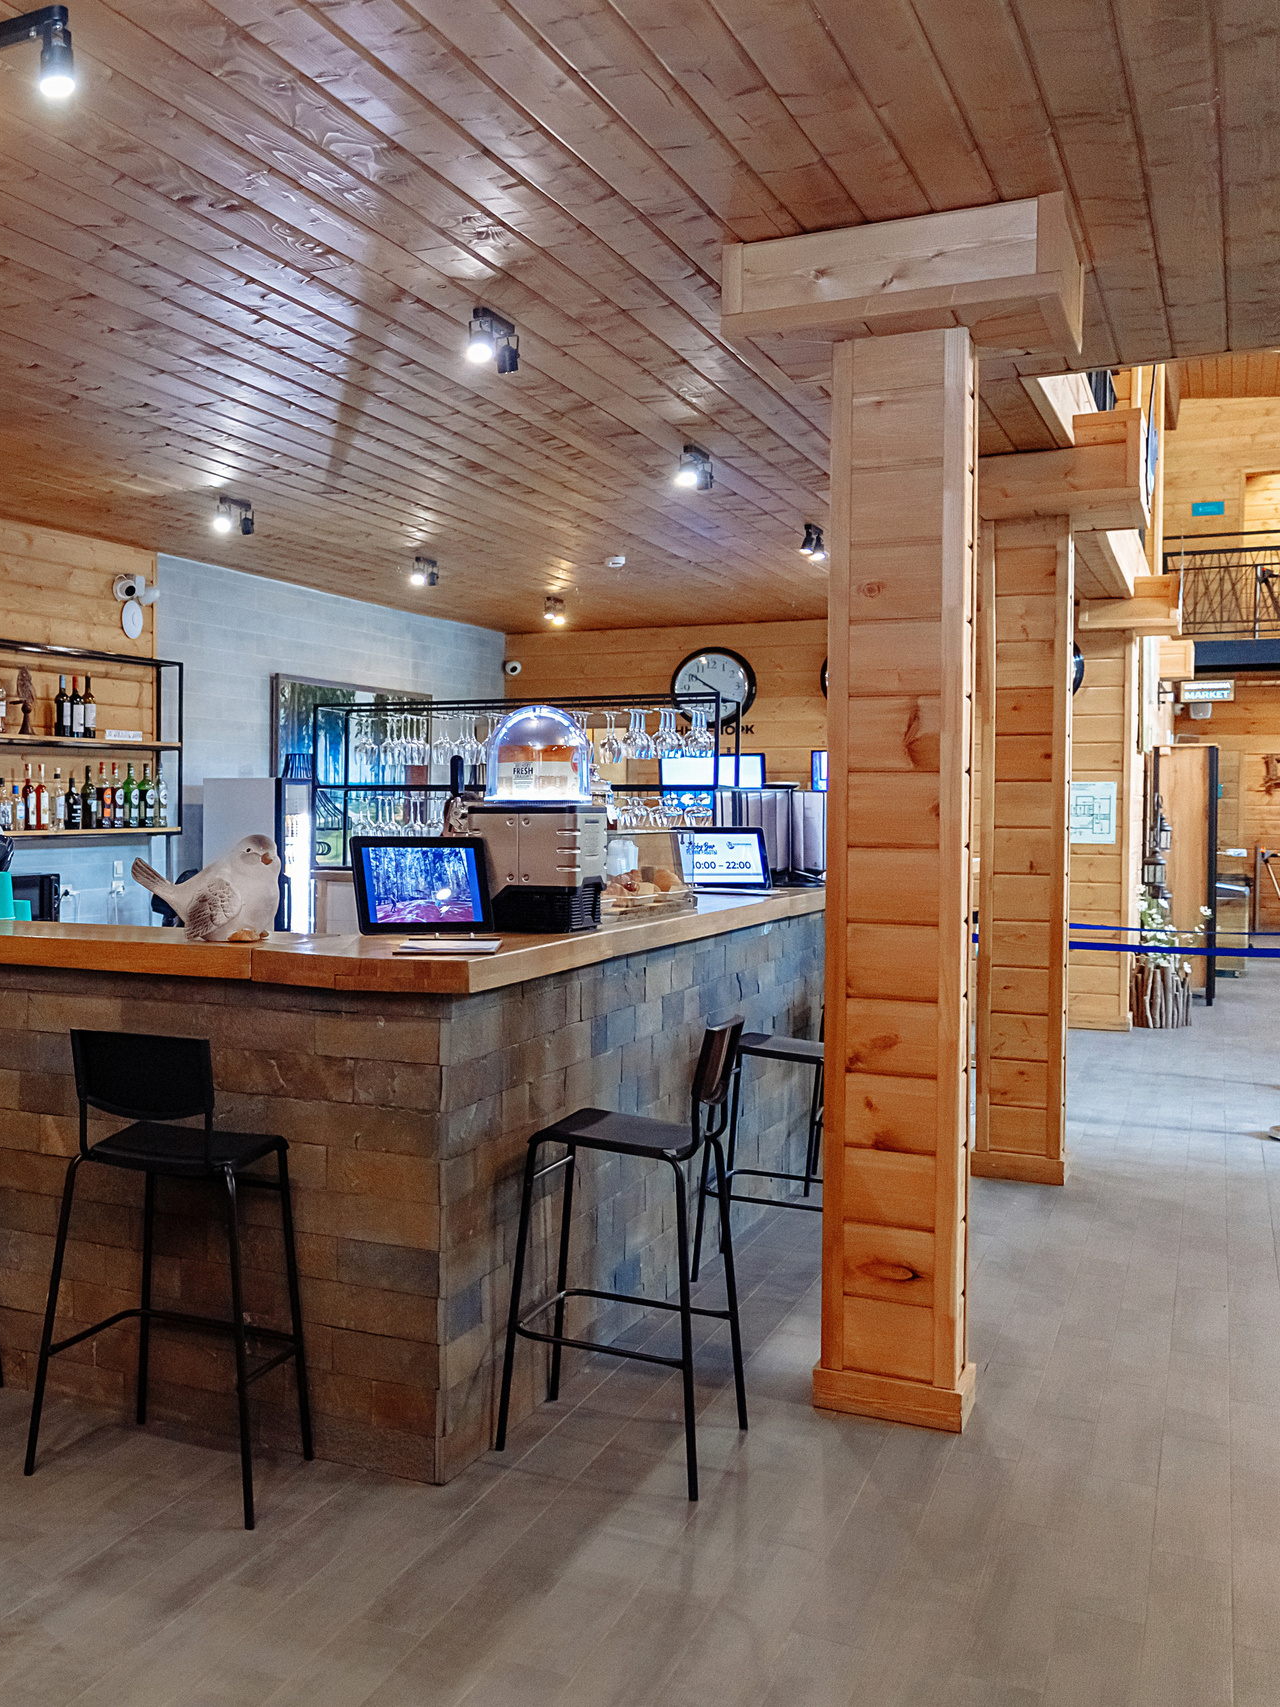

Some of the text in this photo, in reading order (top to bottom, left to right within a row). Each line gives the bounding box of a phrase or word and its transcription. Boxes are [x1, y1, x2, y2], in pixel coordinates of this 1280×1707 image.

[696, 664, 705, 673] 11
[707, 661, 717, 669] 12
[722, 663, 726, 672] 1
[688, 674, 697, 682] 10
[729, 670, 735, 678] 2
[735, 682, 740, 690] 3
[1184, 690, 1230, 700] MARKET
[513, 766, 533, 775] FRESH
[725, 861, 752, 869] 22:00
